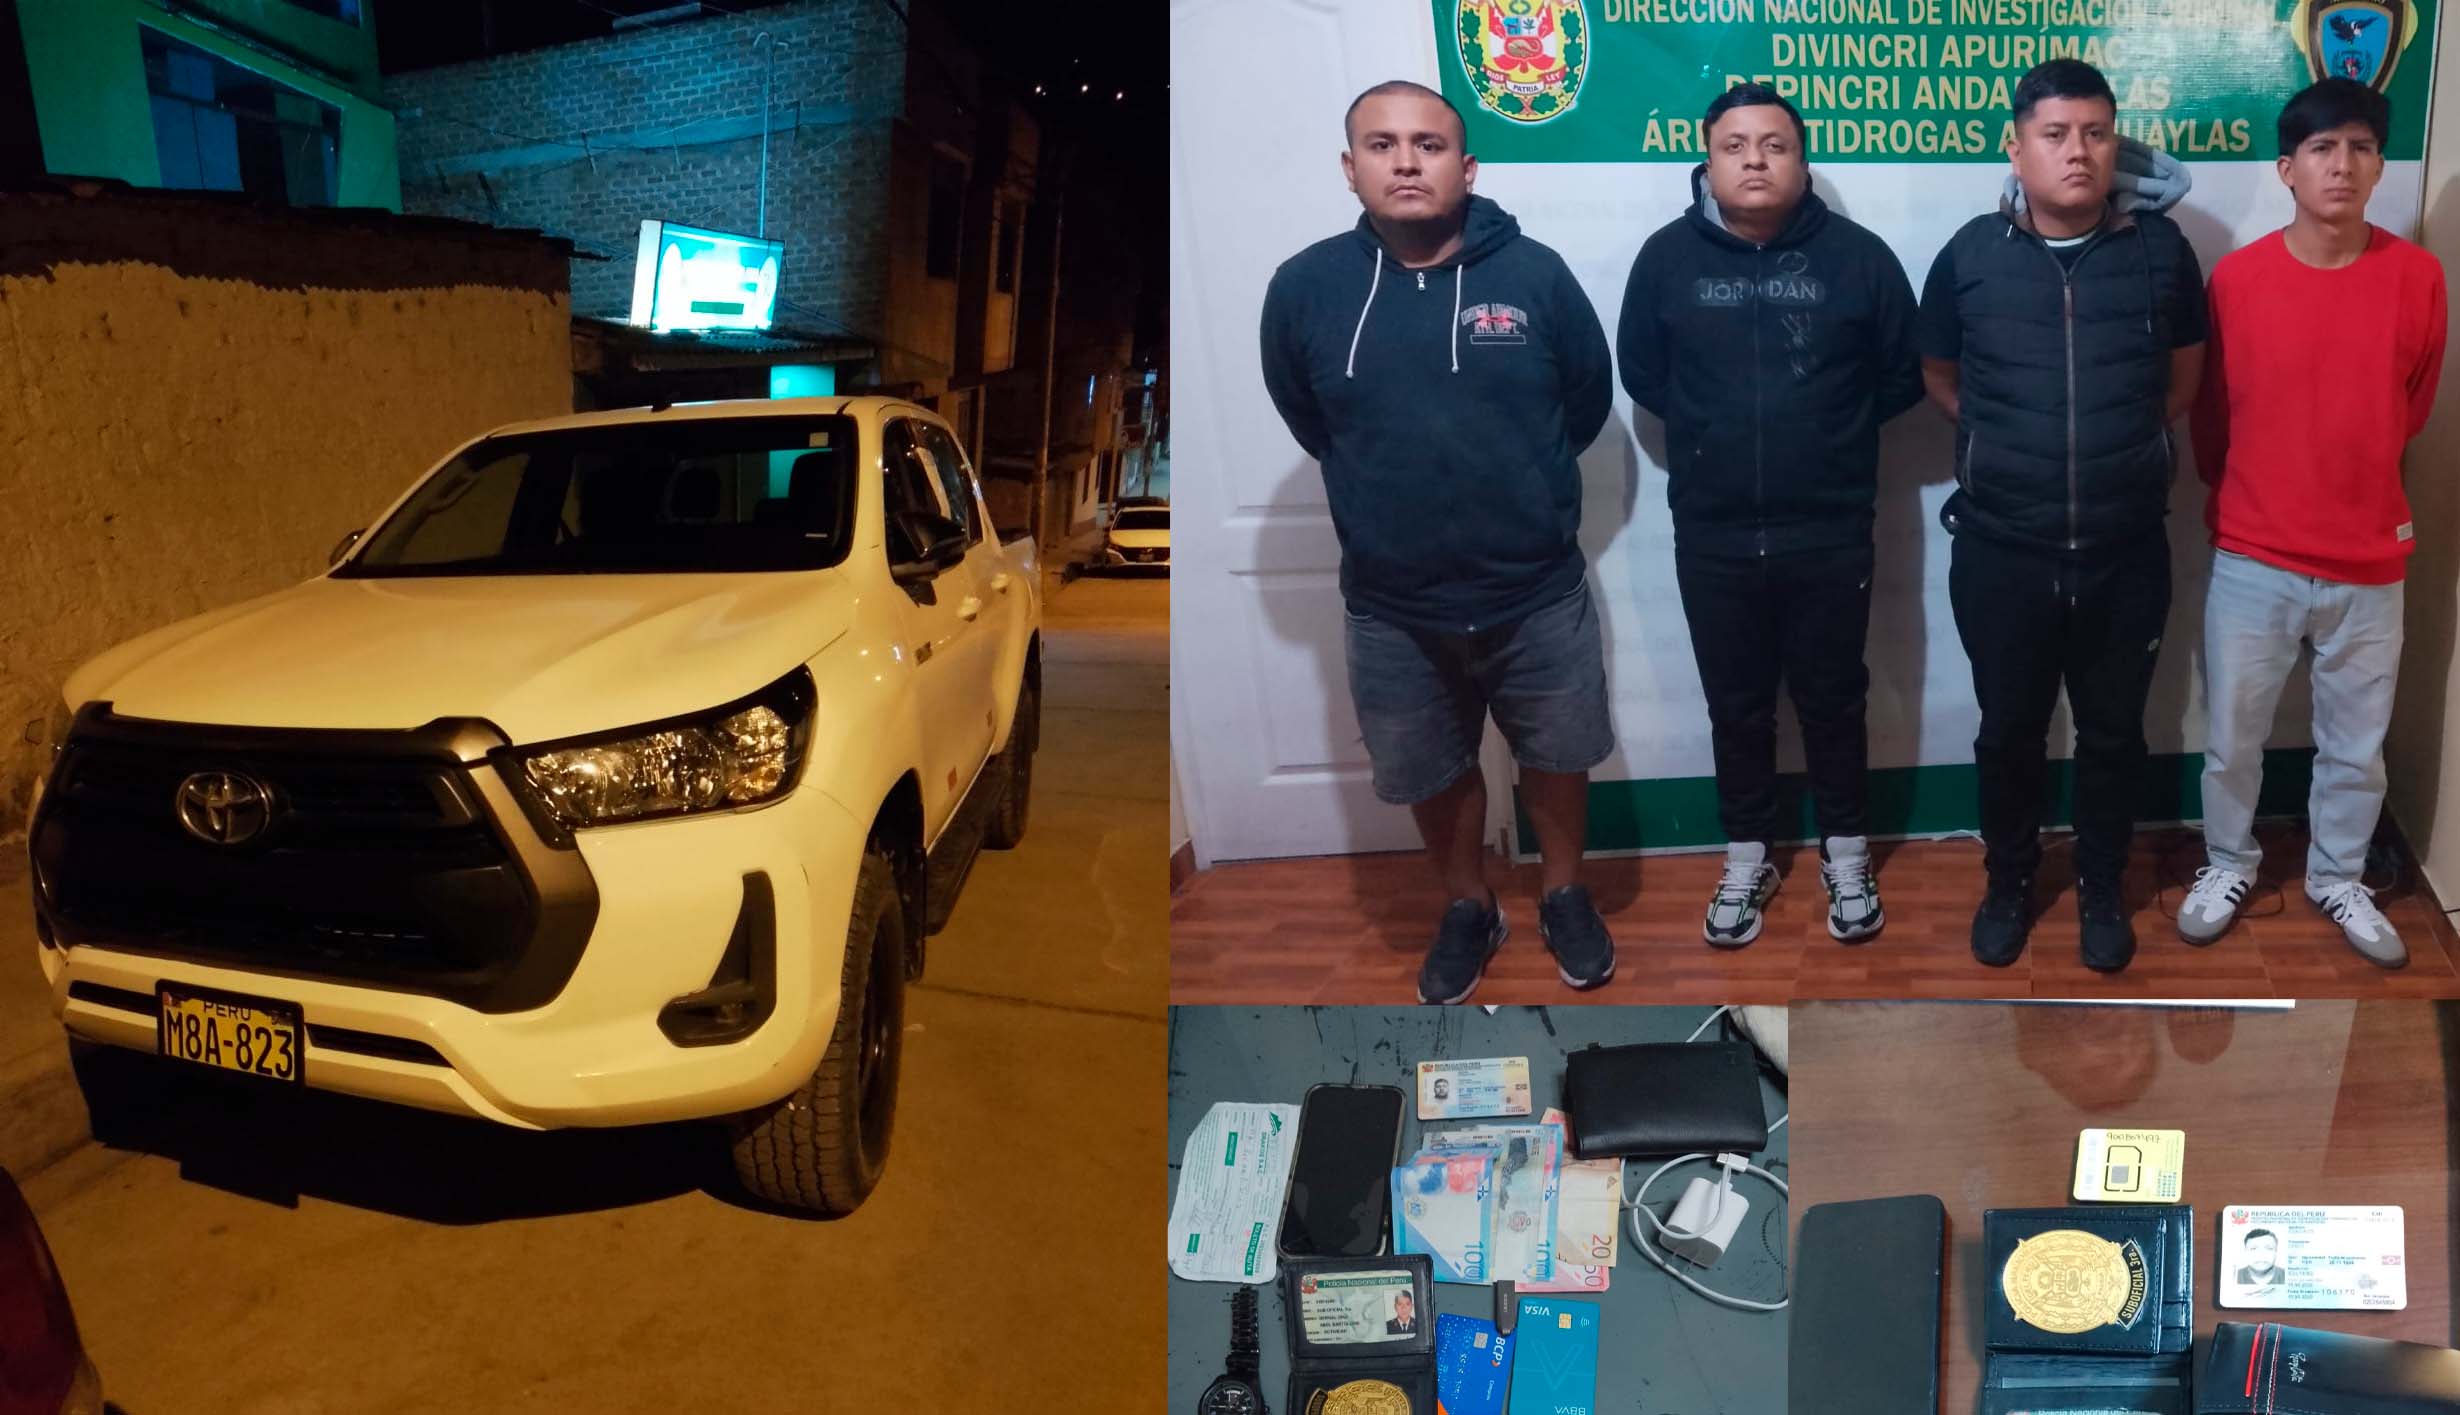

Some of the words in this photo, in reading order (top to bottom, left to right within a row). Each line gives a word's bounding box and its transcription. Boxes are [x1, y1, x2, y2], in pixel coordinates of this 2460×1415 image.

[1765, 0, 1899, 24] NACIONAL
[1908, 0, 1943, 24] DE
[1772, 33, 1928, 68] DIVINCRI
[1939, 27, 2126, 69] APURÍMAC
[1513, 84, 1539, 92] PATRIA
[1545, 73, 1560, 81] LEY
[1725, 74, 1900, 110] PINCRI
[1803, 119, 1986, 154] TIDROGAS
[203, 1001, 251, 1021] PERU
[165, 1008, 293, 1078] M8A-823
[1592, 1234, 1612, 1259] 20
[2128, 1248, 2141, 1268] 3ra.
[1464, 1240, 1484, 1280] 100
[2121, 1267, 2144, 1319] SUBOFICIAL
[1524, 1305, 1550, 1316] VISA
[1492, 1336, 1506, 1361] BCP
[1555, 1406, 1585, 1415] BBVA
